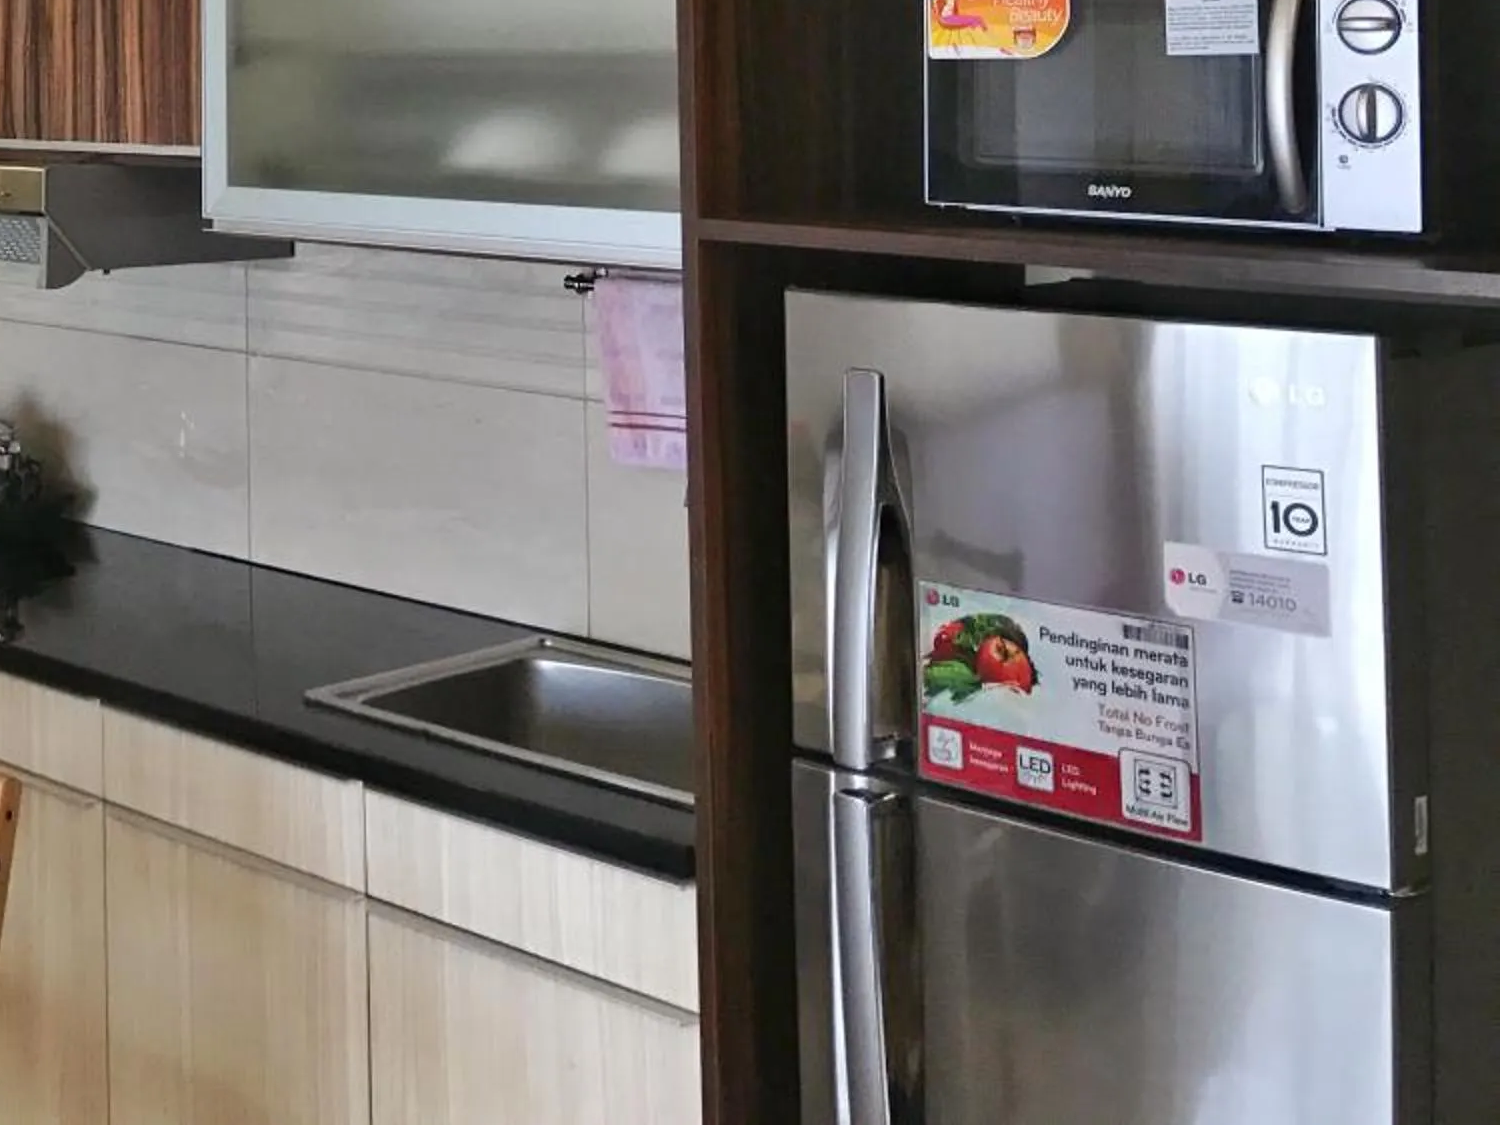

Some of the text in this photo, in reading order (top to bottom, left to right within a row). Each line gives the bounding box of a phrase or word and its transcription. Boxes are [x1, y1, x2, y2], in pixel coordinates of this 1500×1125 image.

[1009, 7, 1063, 25] Beauty
[1088, 184, 1132, 198] SANYO
[1270, 500, 1319, 537] 10
[1188, 572, 1207, 586] LG
[942, 593, 960, 608] LG
[1039, 626, 1188, 668] Pendinginan merata
[1065, 655, 1189, 688] untuk kesegaran
[1072, 676, 1190, 709] yang lebih lama
[1134, 712, 1153, 726] No
[1155, 715, 1189, 733] Frost
[1019, 754, 1051, 774] LED
